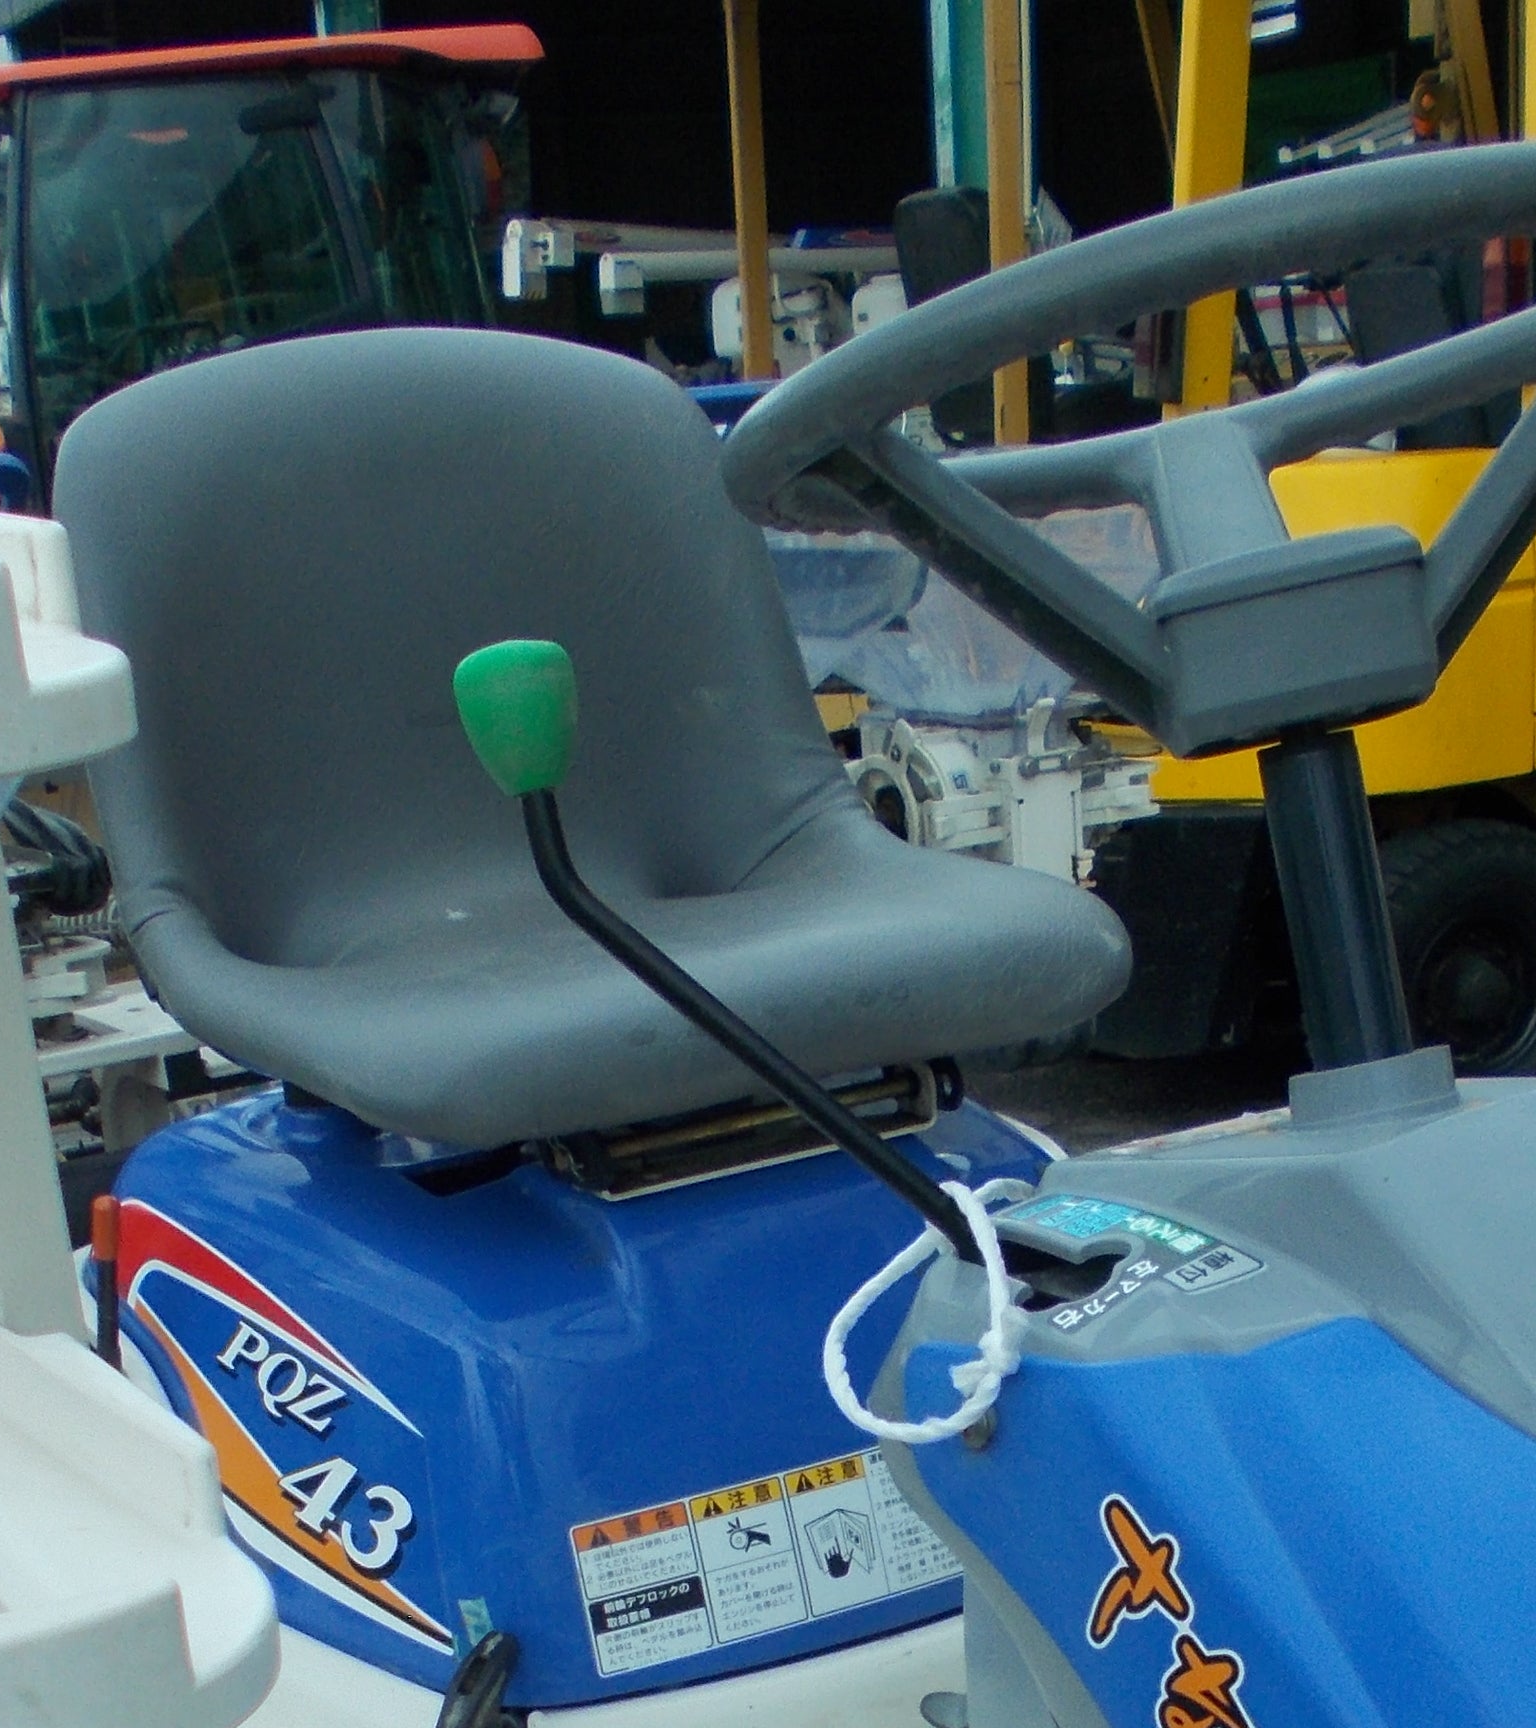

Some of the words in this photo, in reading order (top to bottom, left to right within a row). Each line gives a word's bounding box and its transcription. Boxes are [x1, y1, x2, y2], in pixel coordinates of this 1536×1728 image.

[217, 1321, 351, 1440] PQZ
[728, 1483, 773, 1510] 注意
[816, 1460, 859, 1486] 注意
[277, 1456, 417, 1580] 43
